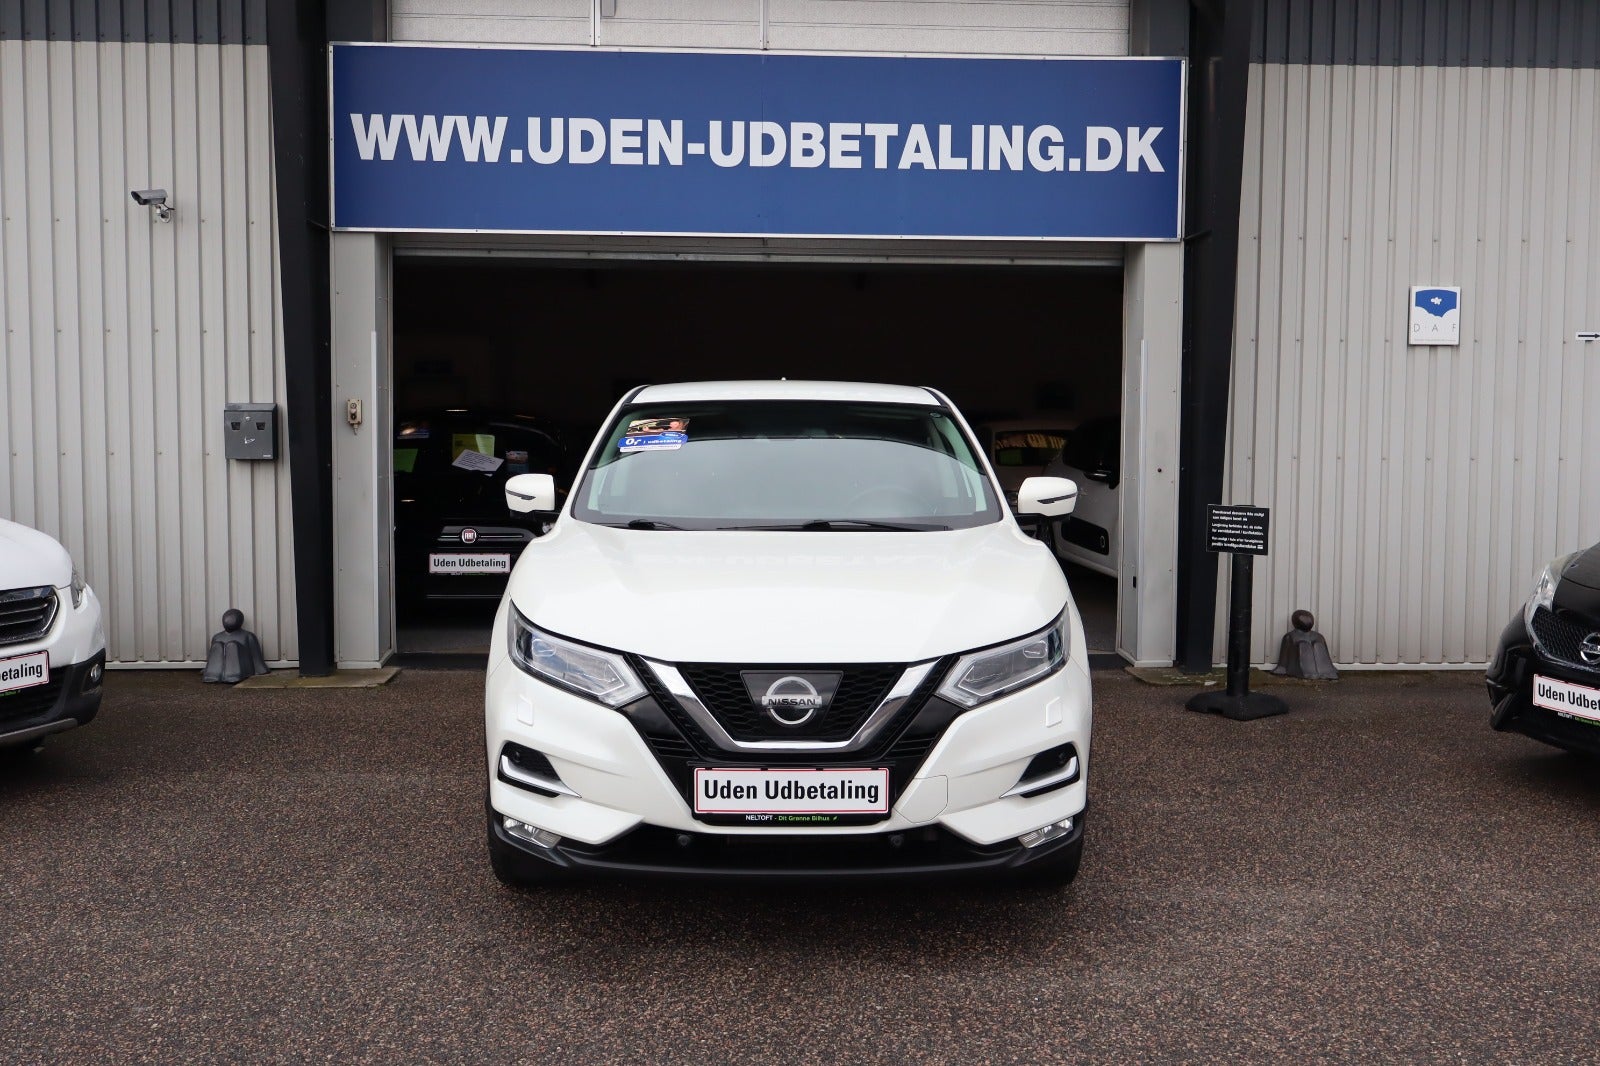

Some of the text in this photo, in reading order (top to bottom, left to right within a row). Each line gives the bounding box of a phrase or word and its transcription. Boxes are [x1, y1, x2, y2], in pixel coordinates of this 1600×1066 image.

[350, 113, 1166, 174] WWW.UDEN-UDBETALING.DK
[433, 558, 507, 569] Uden Udbetaling
[768, 698, 816, 706] NISSAN
[1538, 682, 1565, 703] Uden
[704, 779, 879, 804] Uden Udbetaling
